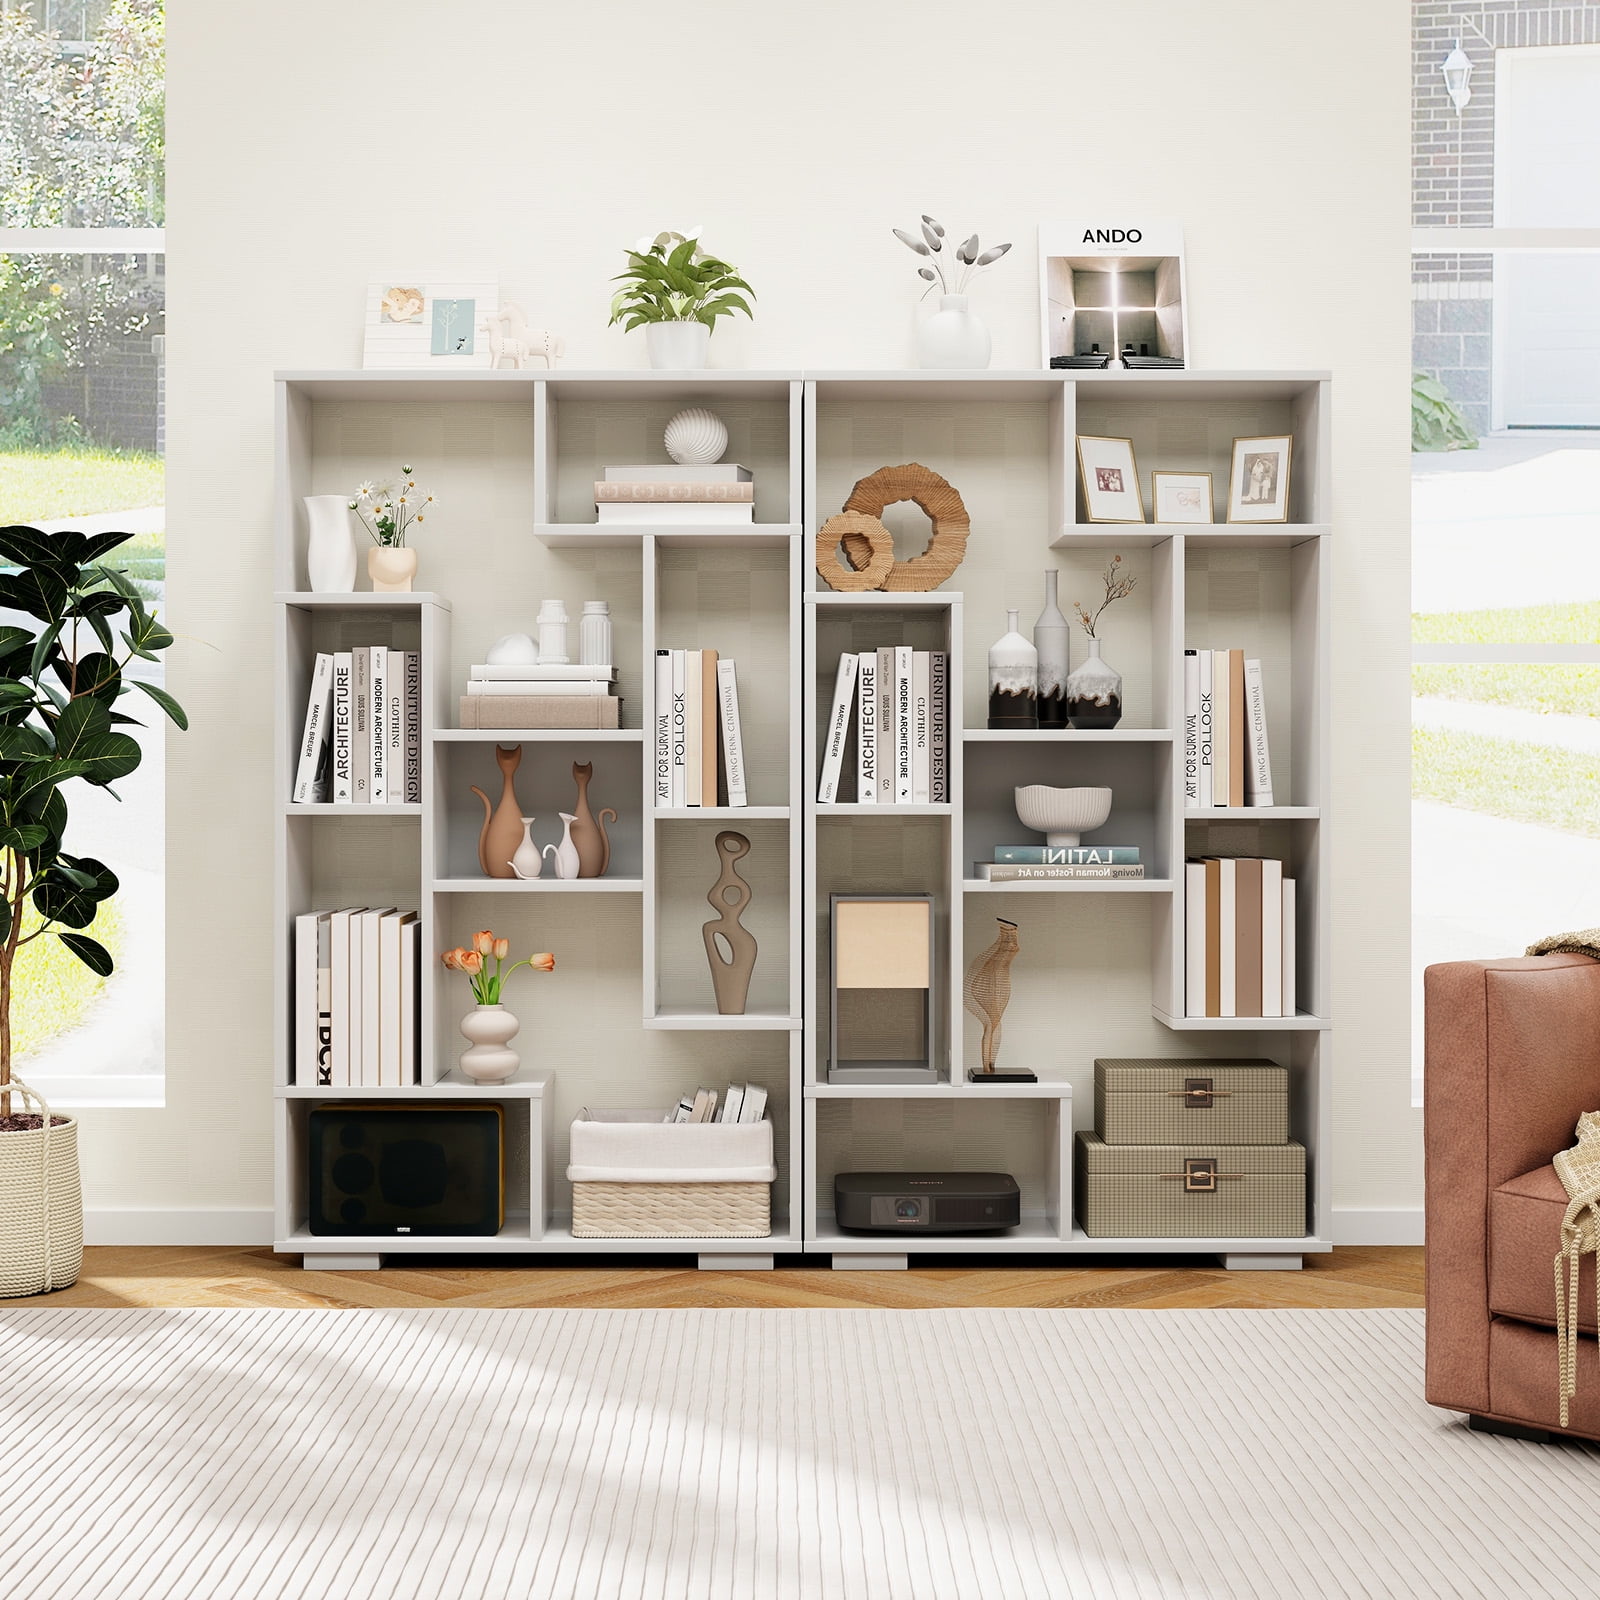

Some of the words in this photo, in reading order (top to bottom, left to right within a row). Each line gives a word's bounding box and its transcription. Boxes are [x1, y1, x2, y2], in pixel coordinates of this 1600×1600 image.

[1082, 229, 1142, 243] ANDO
[310, 704, 319, 730] MARCEL
[408, 654, 418, 742] FURNITURE
[725, 685, 736, 732] CENTENNIAL
[836, 704, 845, 730] MARCEL
[934, 654, 944, 742] FURNITURE
[1253, 685, 1264, 732] CENTENNIAL
[306, 732, 315, 757] BREUER
[337, 667, 349, 780] ARCHITECTURE
[659, 714, 668, 756] SURVIVAL
[674, 693, 684, 766] POLLOCK
[832, 732, 841, 757] BREUER
[862, 667, 874, 780] ARCHITECTURE
[1187, 714, 1196, 756] SURVIVAL
[1202, 693, 1212, 766] POLLOCK
[408, 747, 418, 802] DESIGN
[659, 759, 668, 777] FOR
[730, 757, 740, 786] IRVING
[934, 747, 944, 802] DESIGN
[1187, 759, 1196, 777] FOR
[1258, 757, 1268, 786] IRVING
[659, 781, 668, 798] ART
[1187, 781, 1196, 798] ART
